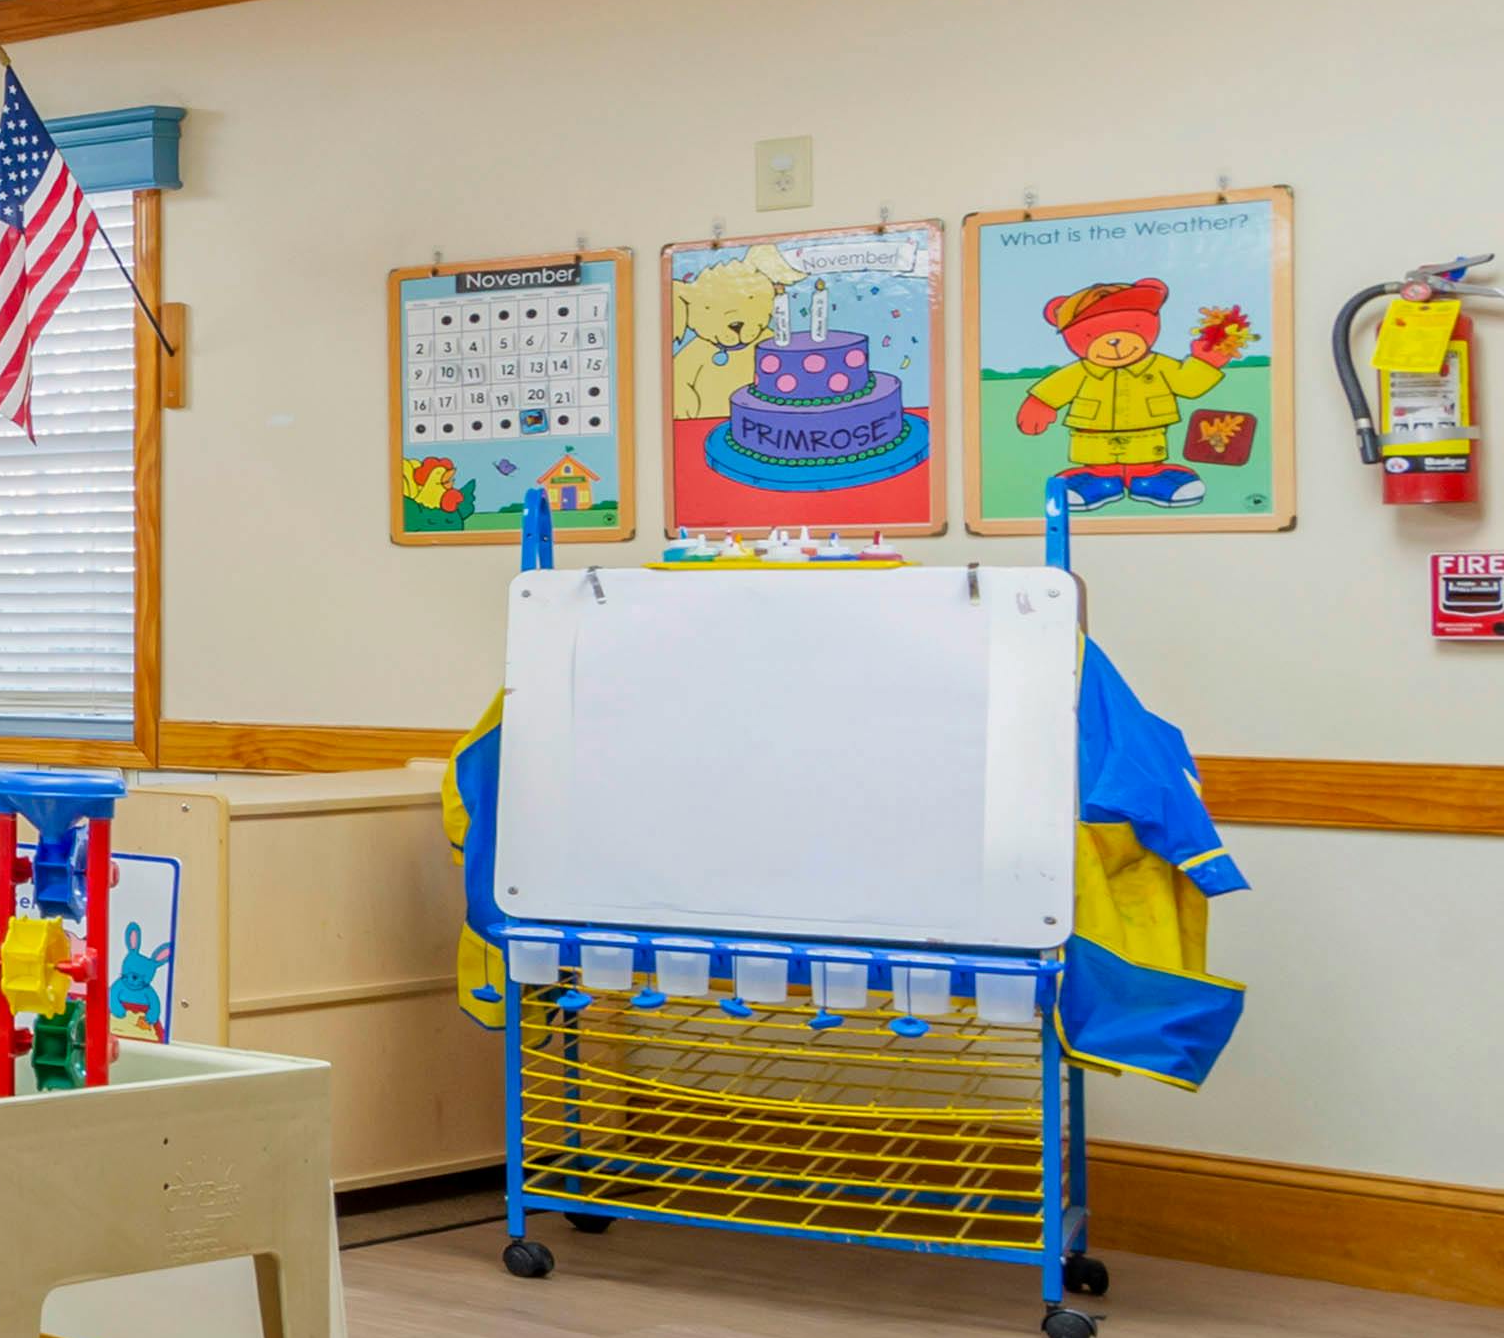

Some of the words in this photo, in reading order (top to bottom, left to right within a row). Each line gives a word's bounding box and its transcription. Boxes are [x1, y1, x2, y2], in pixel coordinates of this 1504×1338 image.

[1000, 229, 1060, 247] What
[1068, 227, 1081, 242] is
[1089, 225, 1126, 241] the
[1134, 213, 1249, 236] Weather?
[801, 250, 897, 270] November
[416, 343, 424, 355] 2
[444, 342, 452, 353] 3
[469, 341, 478, 352] 4
[500, 338, 508, 349] 5
[526, 335, 534, 346] 6
[560, 332, 568, 343] 7
[587, 333, 597, 345] 8
[414, 370, 423, 381] 9
[441, 366, 454, 378] 10
[468, 367, 480, 379] 11
[501, 364, 515, 376] 12
[530, 362, 544, 373] 13
[553, 360, 568, 371] 14
[587, 358, 602, 371] 15
[413, 400, 427, 411] 16
[439, 397, 452, 408] 17
[470, 392, 485, 404] 18
[496, 395, 509, 406] 19
[528, 389, 545, 400] 20
[555, 392, 571, 403] 21
[741, 416, 889, 452] PRIMROSE
[1438, 556, 1504, 574] FIRE
